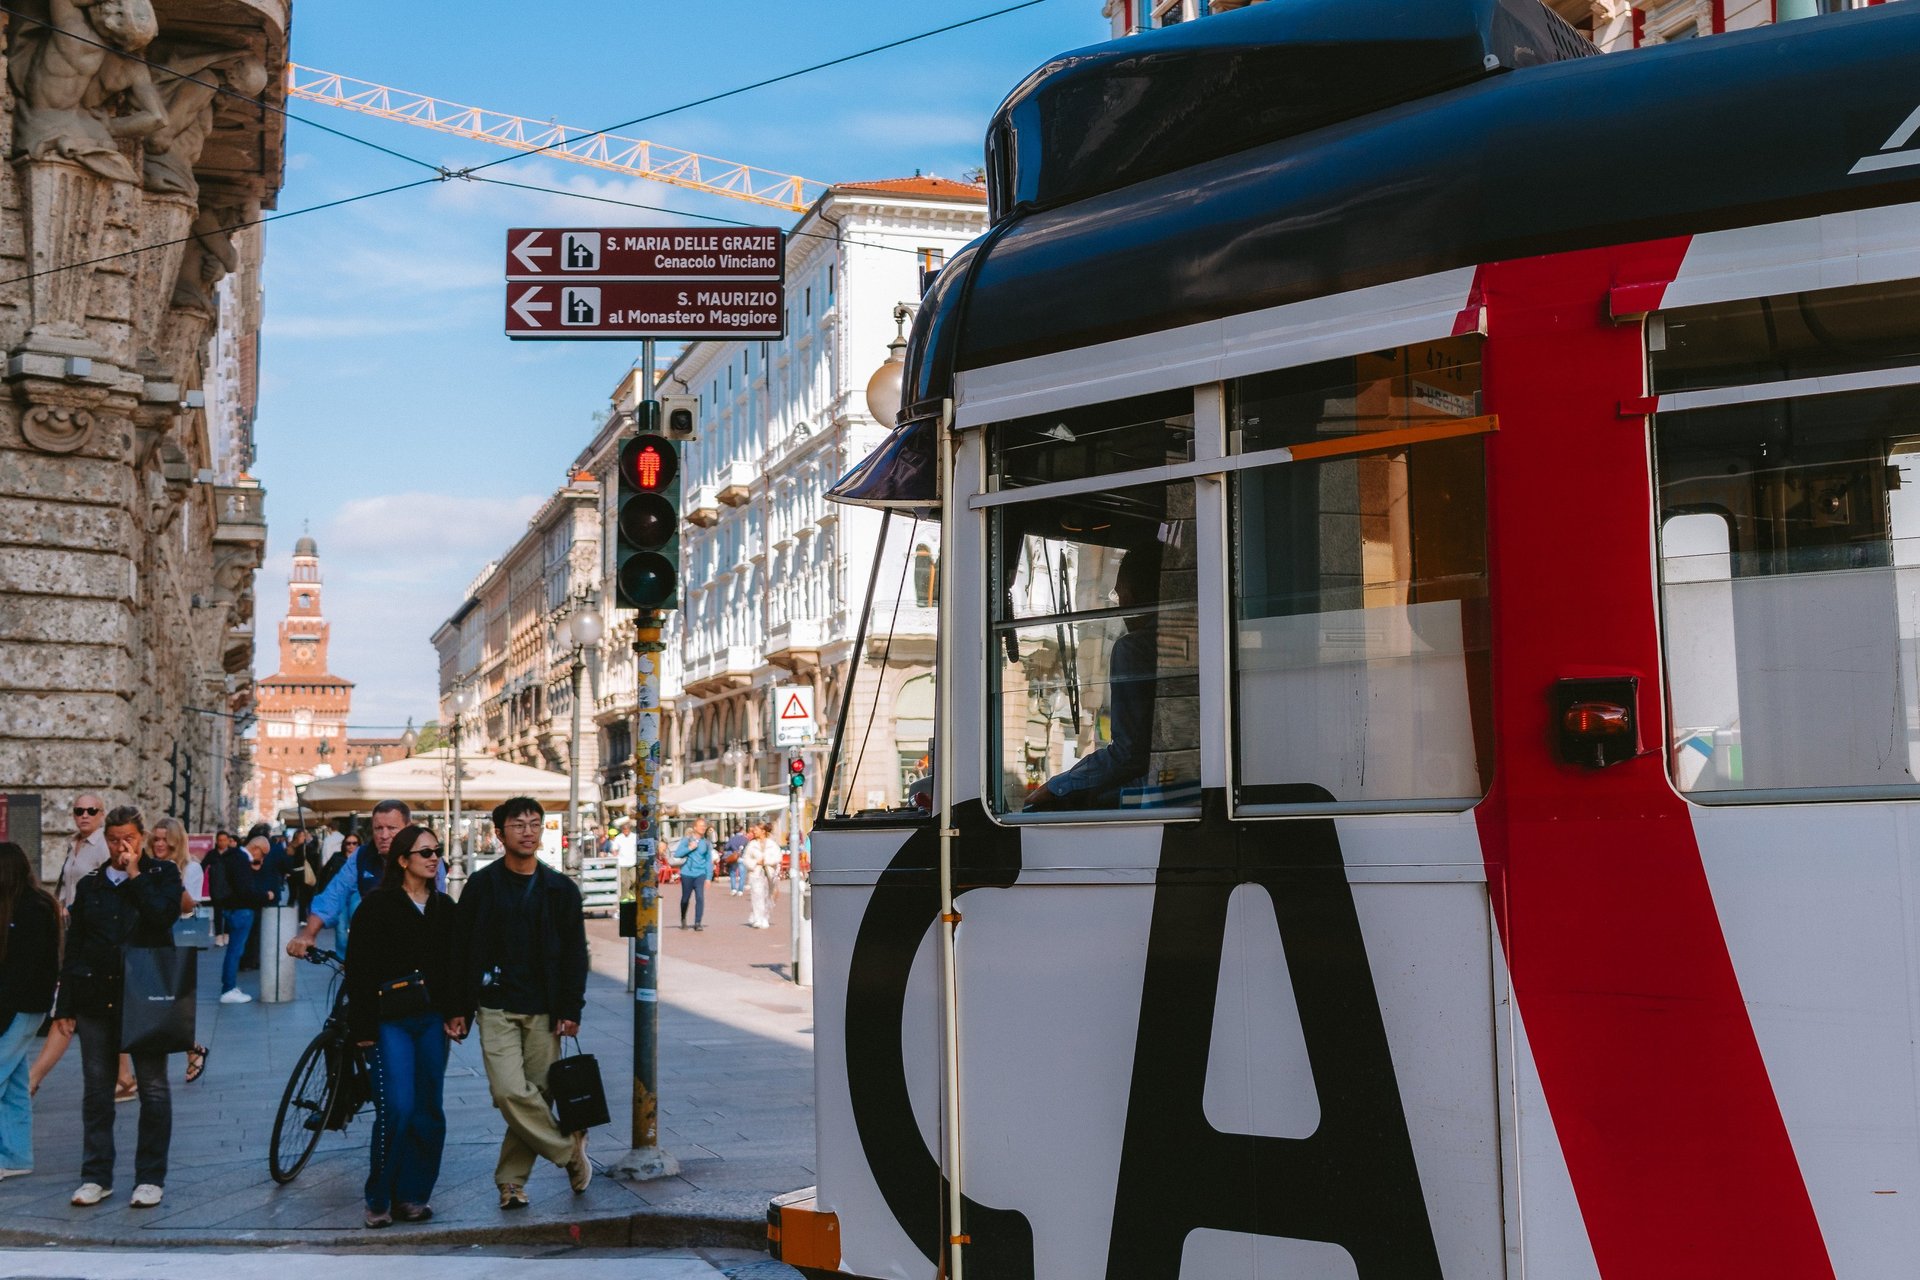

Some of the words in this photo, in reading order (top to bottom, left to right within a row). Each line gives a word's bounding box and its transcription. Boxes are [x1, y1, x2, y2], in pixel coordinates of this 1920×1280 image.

[607, 237, 620, 251] S.
[625, 237, 672, 251] MARIA
[674, 237, 718, 251] DELLE
[722, 236, 775, 251] GRAZIE
[655, 254, 716, 269] Cenacolo
[719, 254, 776, 269] Vinciano
[677, 292, 692, 306] S.
[697, 292, 777, 306] MAURIZIO
[609, 310, 623, 324] al
[628, 310, 705, 324] Monastero
[709, 310, 777, 327] Maggiore
